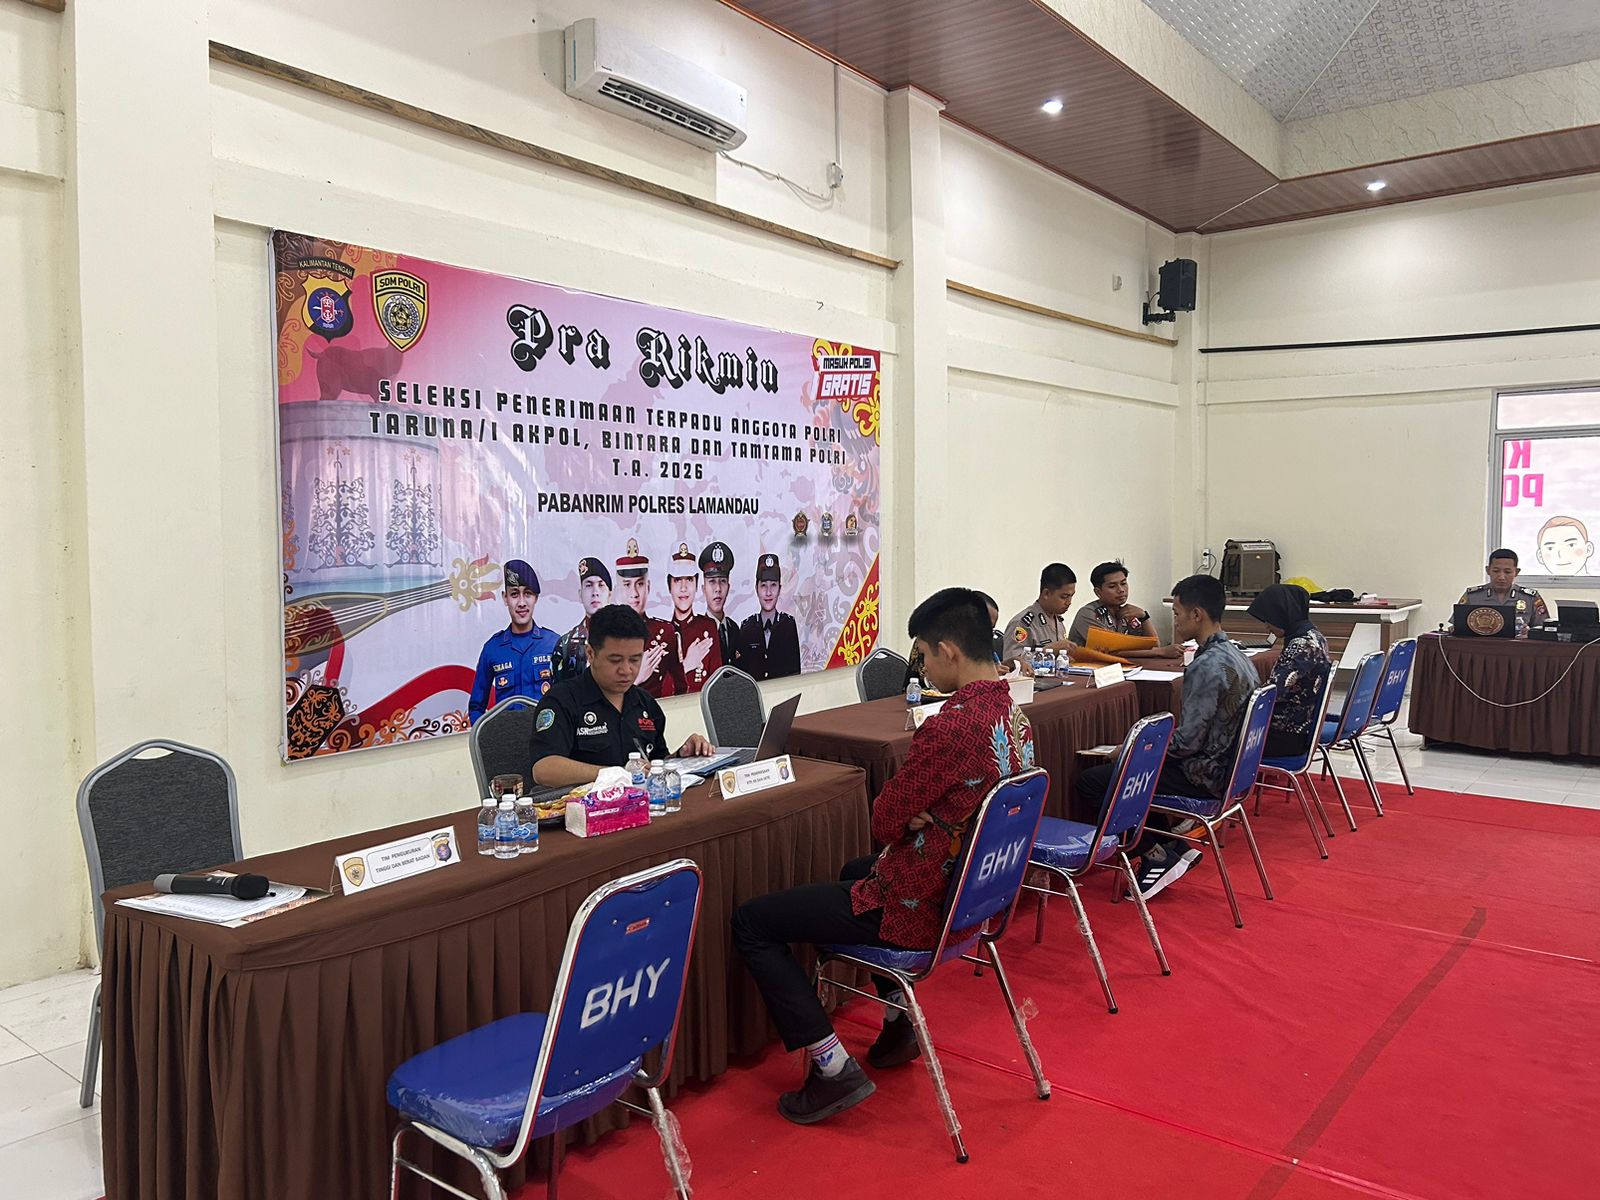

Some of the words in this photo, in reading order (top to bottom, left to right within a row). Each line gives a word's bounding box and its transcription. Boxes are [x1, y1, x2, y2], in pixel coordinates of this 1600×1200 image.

[299, 259, 333, 269] KALIMANTAN
[332, 261, 354, 277] TENGAH
[379, 277, 397, 288] SDM
[397, 277, 421, 292] POLRI
[506, 304, 612, 372] Pra
[636, 327, 779, 394] Rikmin
[823, 357, 849, 369] MASUK
[849, 357, 872, 369] POLISI
[821, 373, 873, 397] GRATIS
[379, 380, 482, 410] SELEKSI
[496, 391, 636, 425] PENERIMAAN
[646, 409, 722, 432] TERPADU
[731, 417, 797, 439] ANGGOTA
[804, 425, 842, 444] POLRI
[370, 412, 498, 443] TARUNA/I
[512, 423, 590, 450] AKPOL,
[602, 430, 681, 455] BINTARA
[691, 438, 722, 457] DAN
[731, 441, 802, 463] TAMTAMA
[809, 447, 846, 466] POLRI
[612, 458, 649, 478] T.A.
[660, 461, 704, 480] 2026
[537, 492, 624, 514] PABANRIM
[629, 494, 685, 514] POLRES
[688, 496, 760, 515] LAMANDAU
[1387, 669, 1407, 686] BHY
[1122, 768, 1155, 800] BHY
[978, 836, 1026, 881] BHY
[580, 957, 671, 1029] BHY
